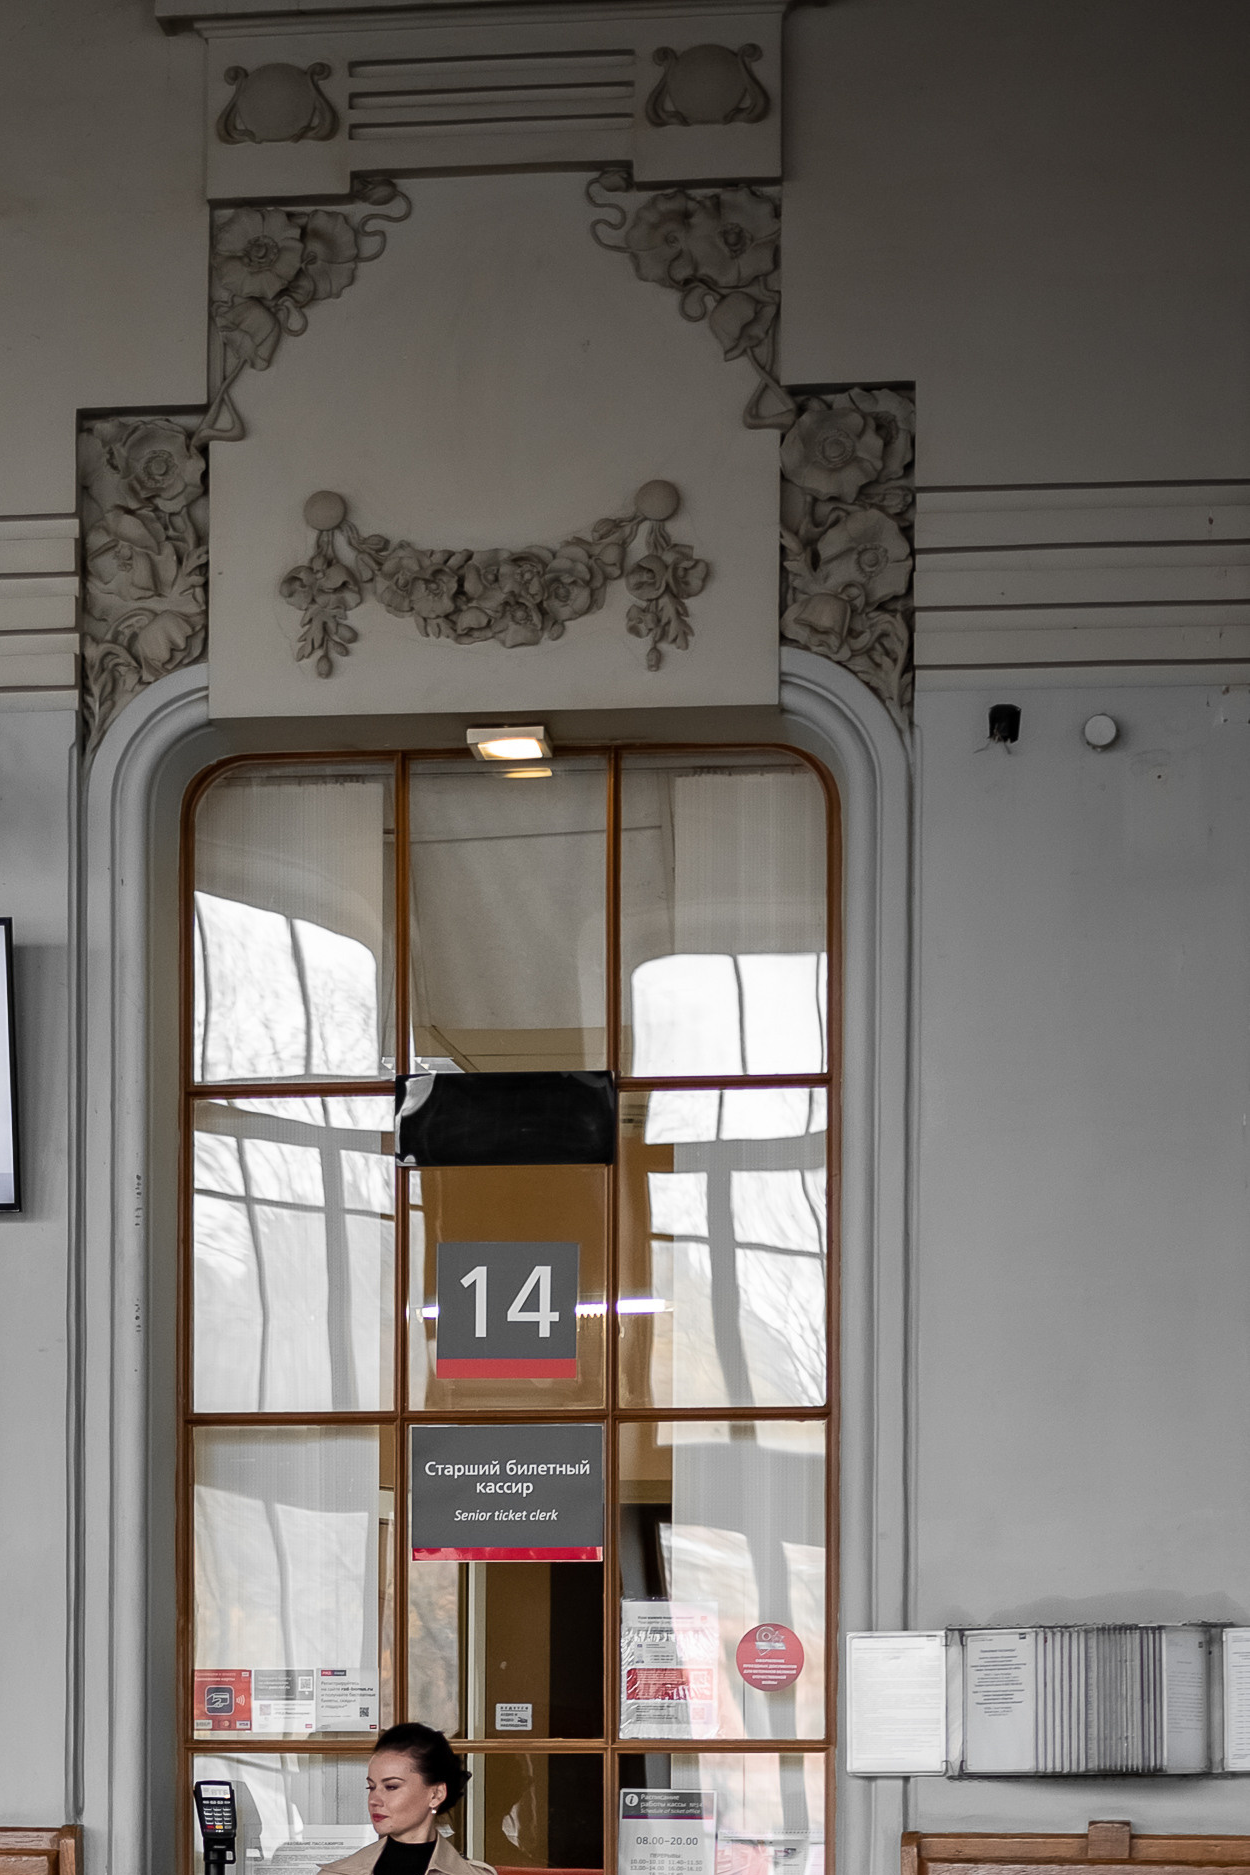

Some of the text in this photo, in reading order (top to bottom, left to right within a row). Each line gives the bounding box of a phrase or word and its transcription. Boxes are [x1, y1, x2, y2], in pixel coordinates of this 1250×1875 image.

[460, 1266, 559, 1338] 14
[425, 1460, 590, 1478] Старший билетный
[476, 1482, 534, 1497] кассир
[454, 1509, 558, 1521] Senior ticket clerk
